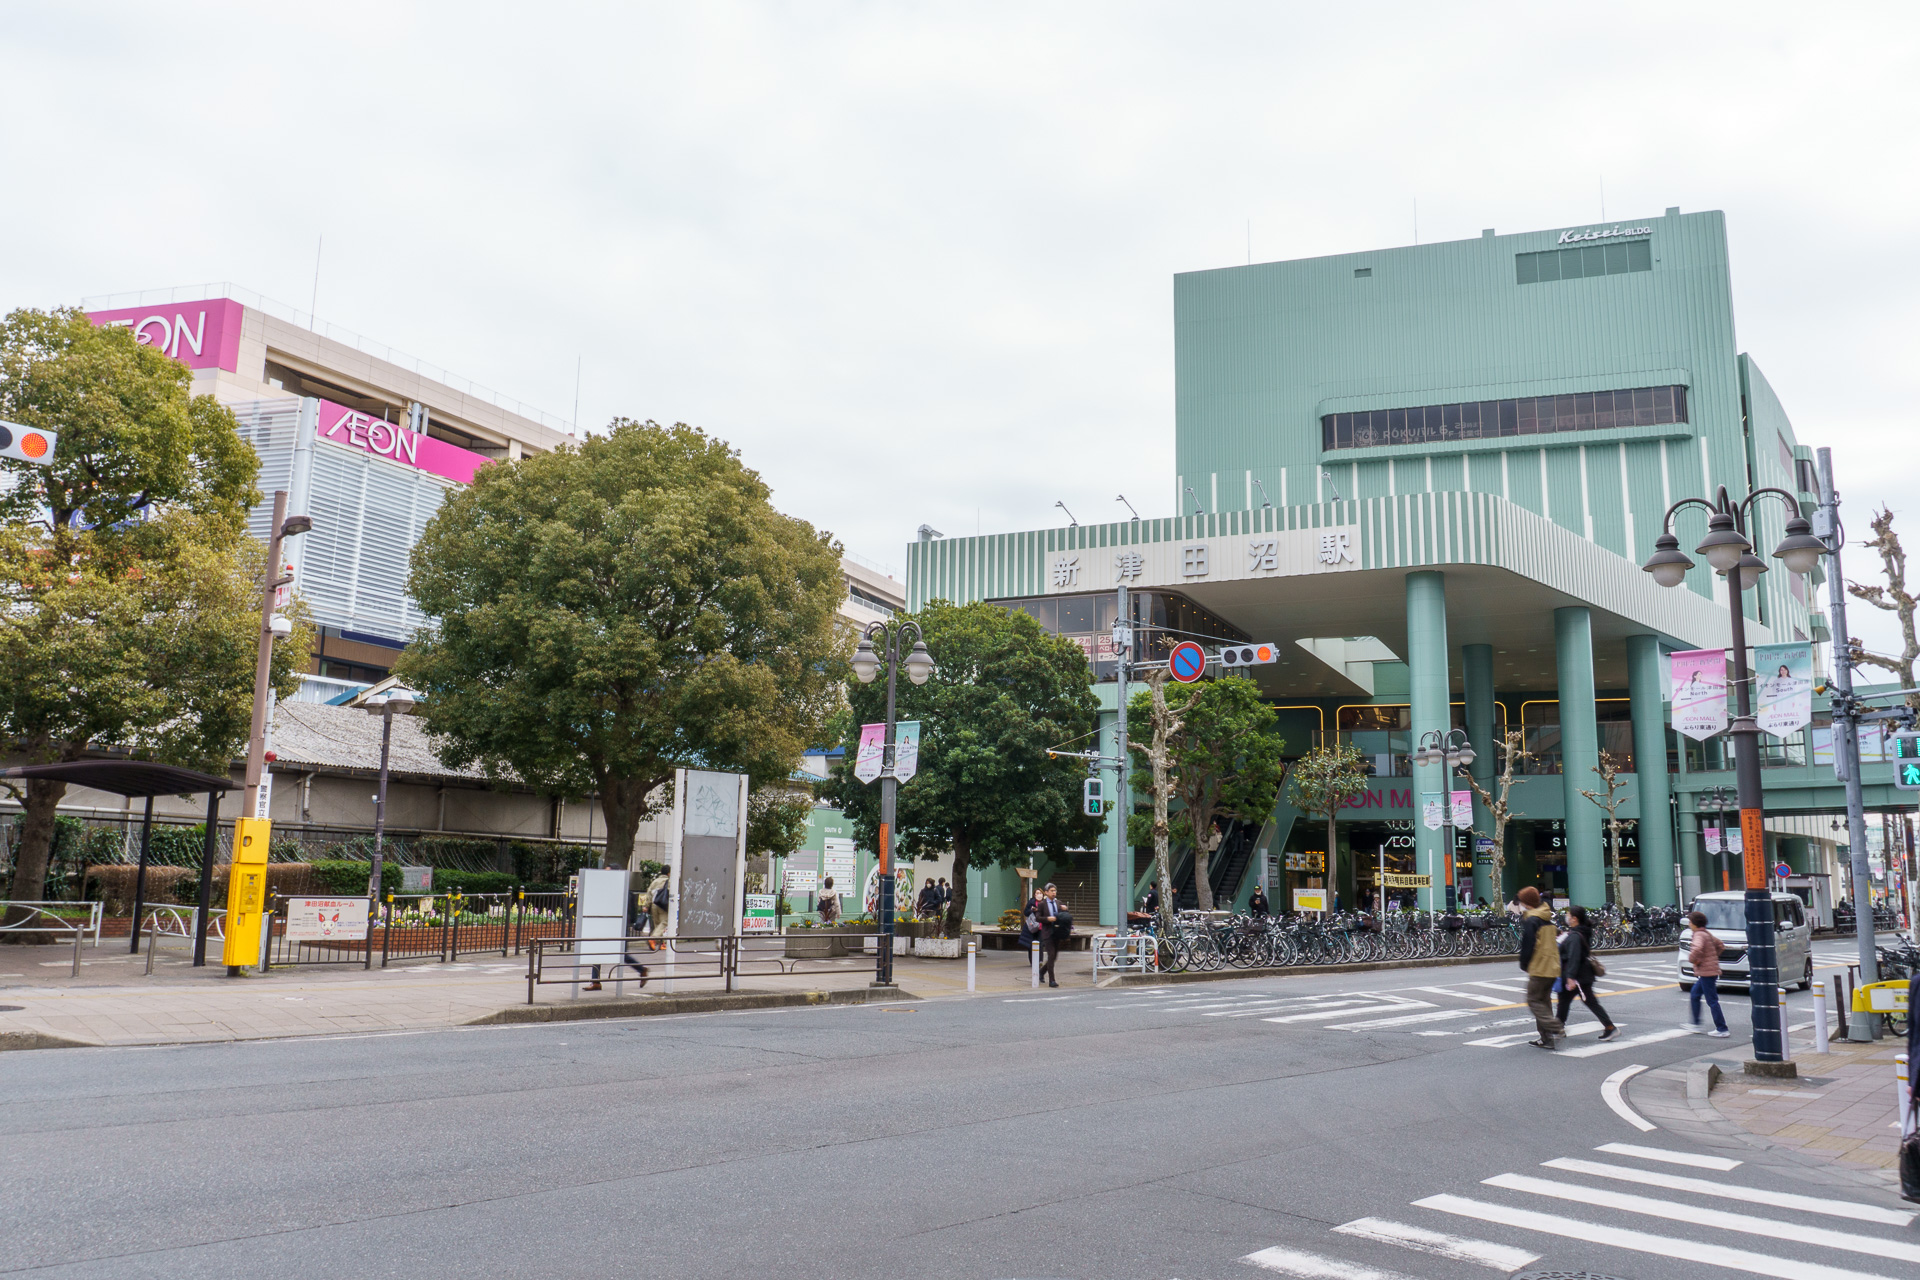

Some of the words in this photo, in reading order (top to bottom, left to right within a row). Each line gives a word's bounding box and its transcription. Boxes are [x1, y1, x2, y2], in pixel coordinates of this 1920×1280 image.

[1558, 225, 1624, 244] Keisei
[1053, 532, 1354, 587] 新津田沼駅
[1100, 636, 1111, 644] 25
[304, 900, 355, 908] 津田沼献血ルーム
